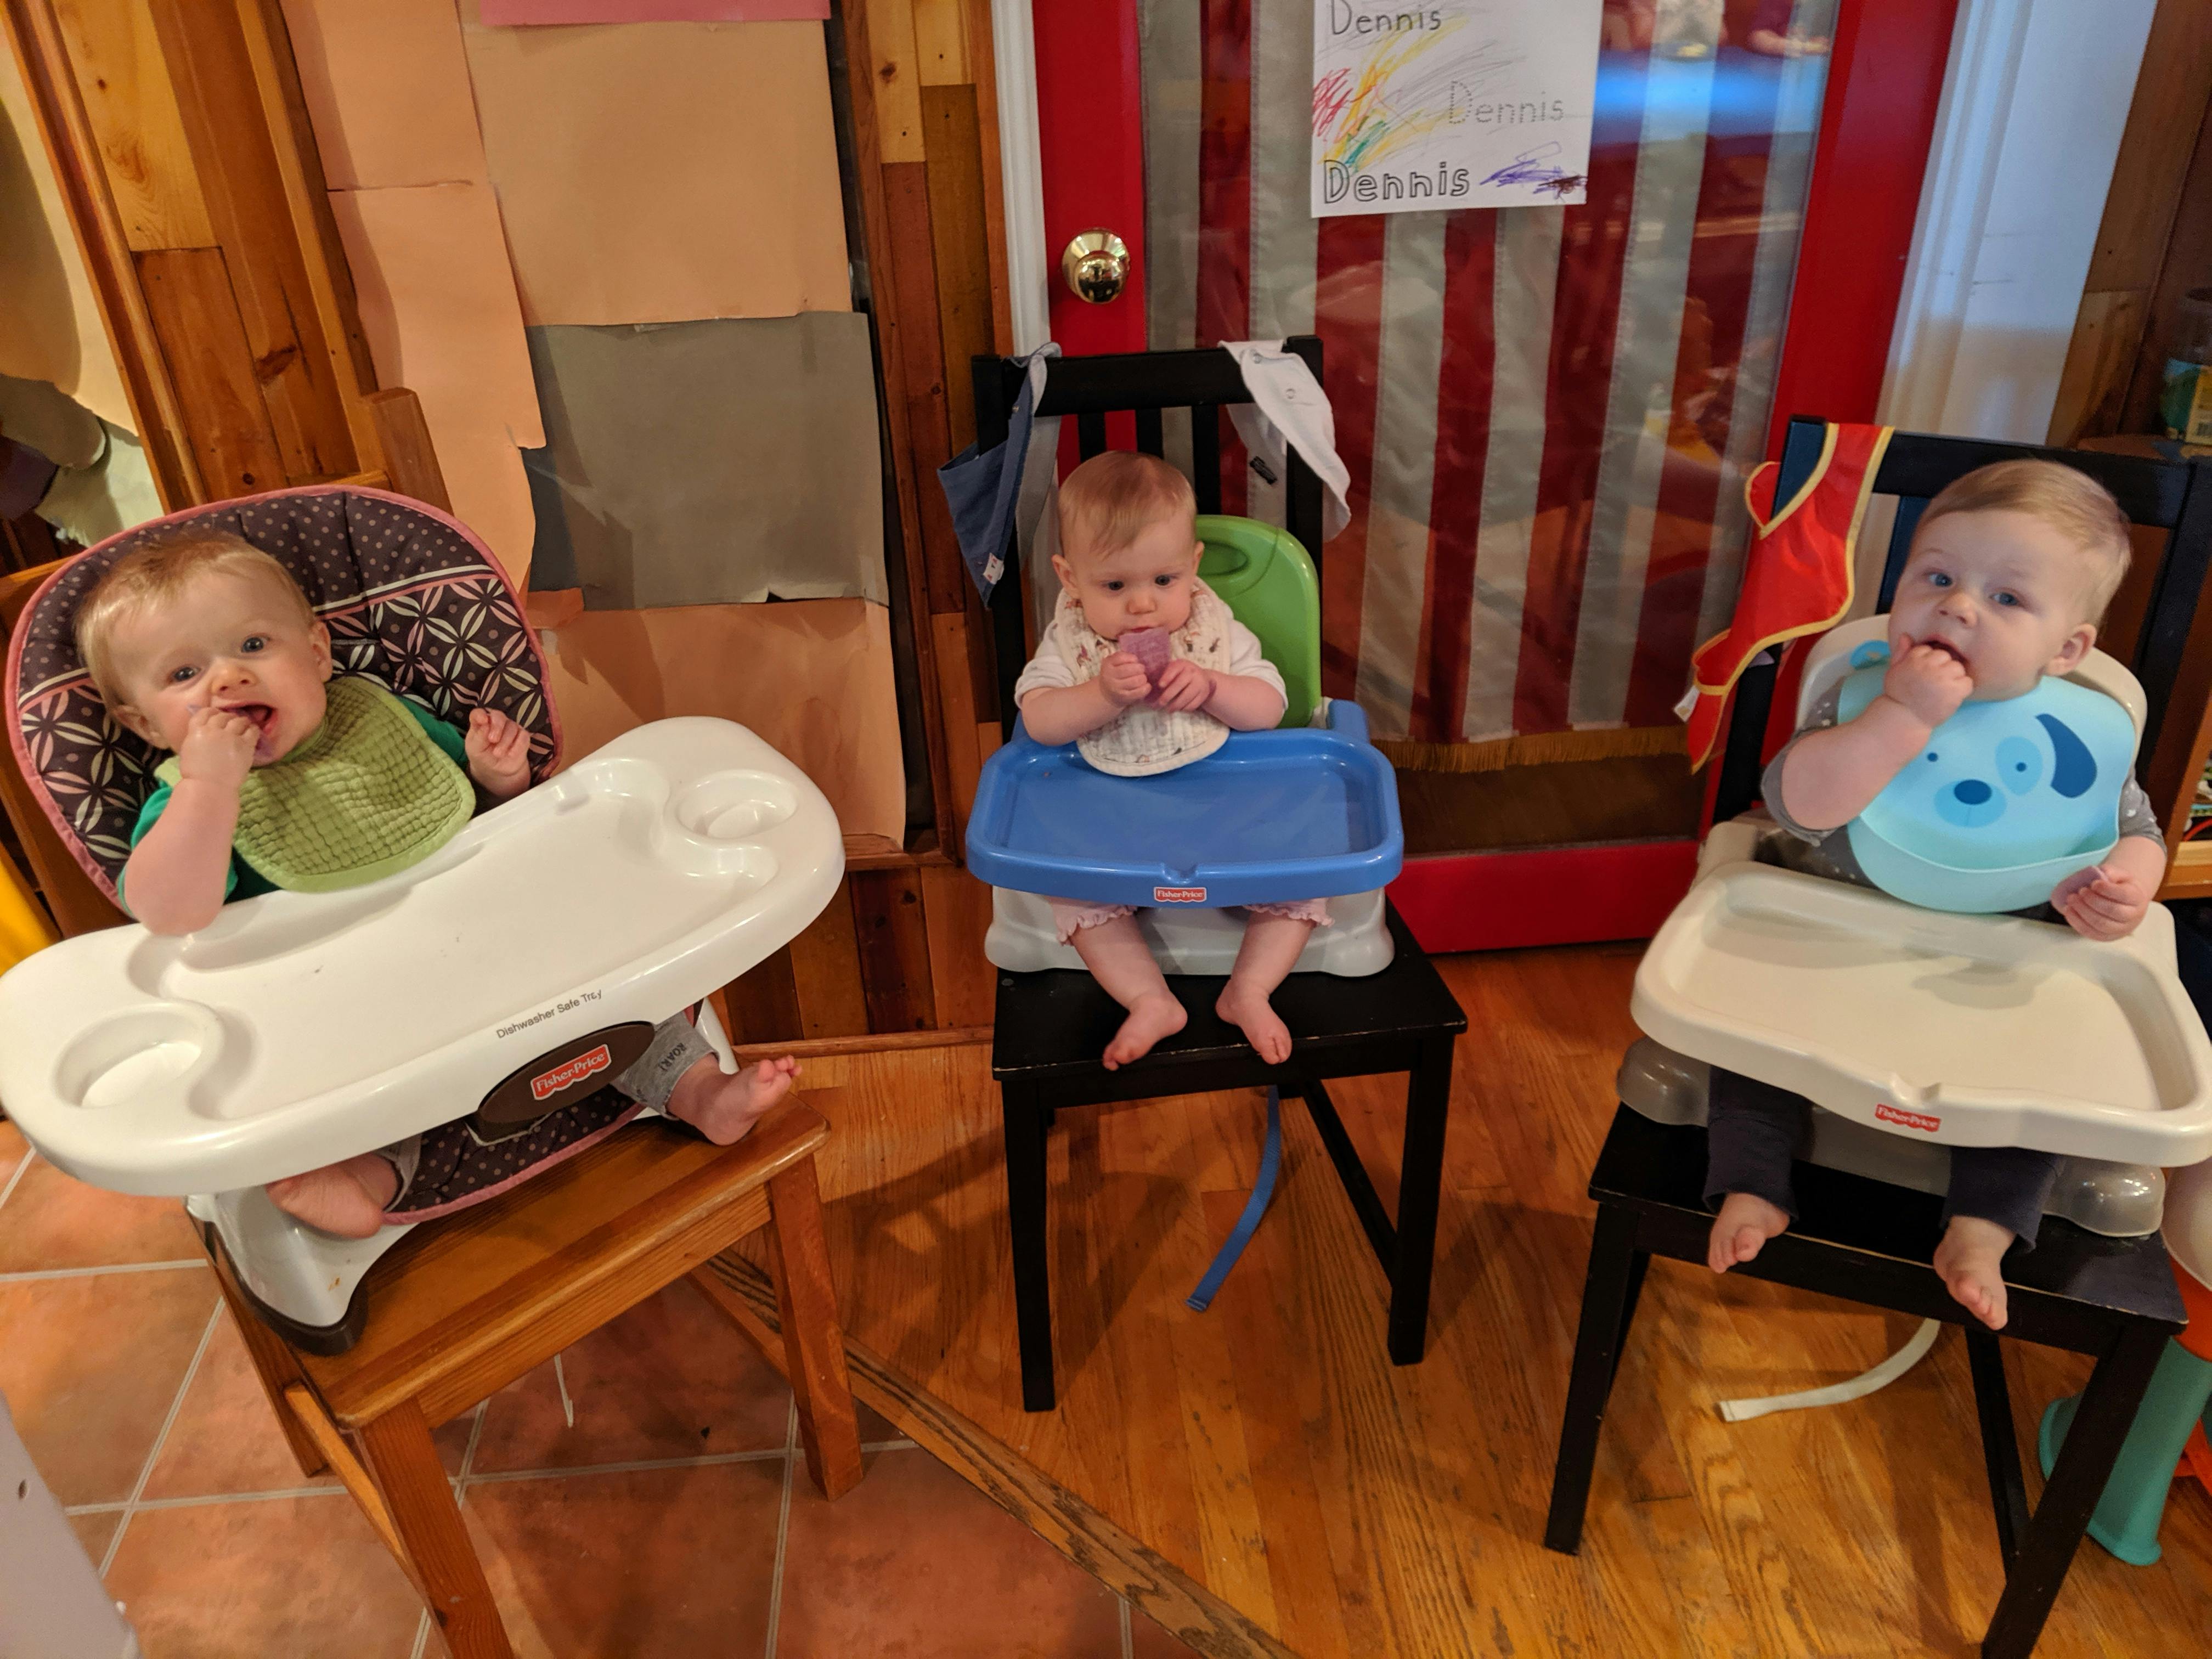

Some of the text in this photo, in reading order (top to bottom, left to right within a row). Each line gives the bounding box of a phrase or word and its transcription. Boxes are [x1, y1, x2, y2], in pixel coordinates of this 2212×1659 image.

[1331, 0, 1441, 35] Dennis
[1448, 81, 1564, 125] Dennis
[1324, 160, 1470, 204] Dennis
[496, 1009, 555, 1039] Dishwasher
[556, 998, 580, 1014] Safe
